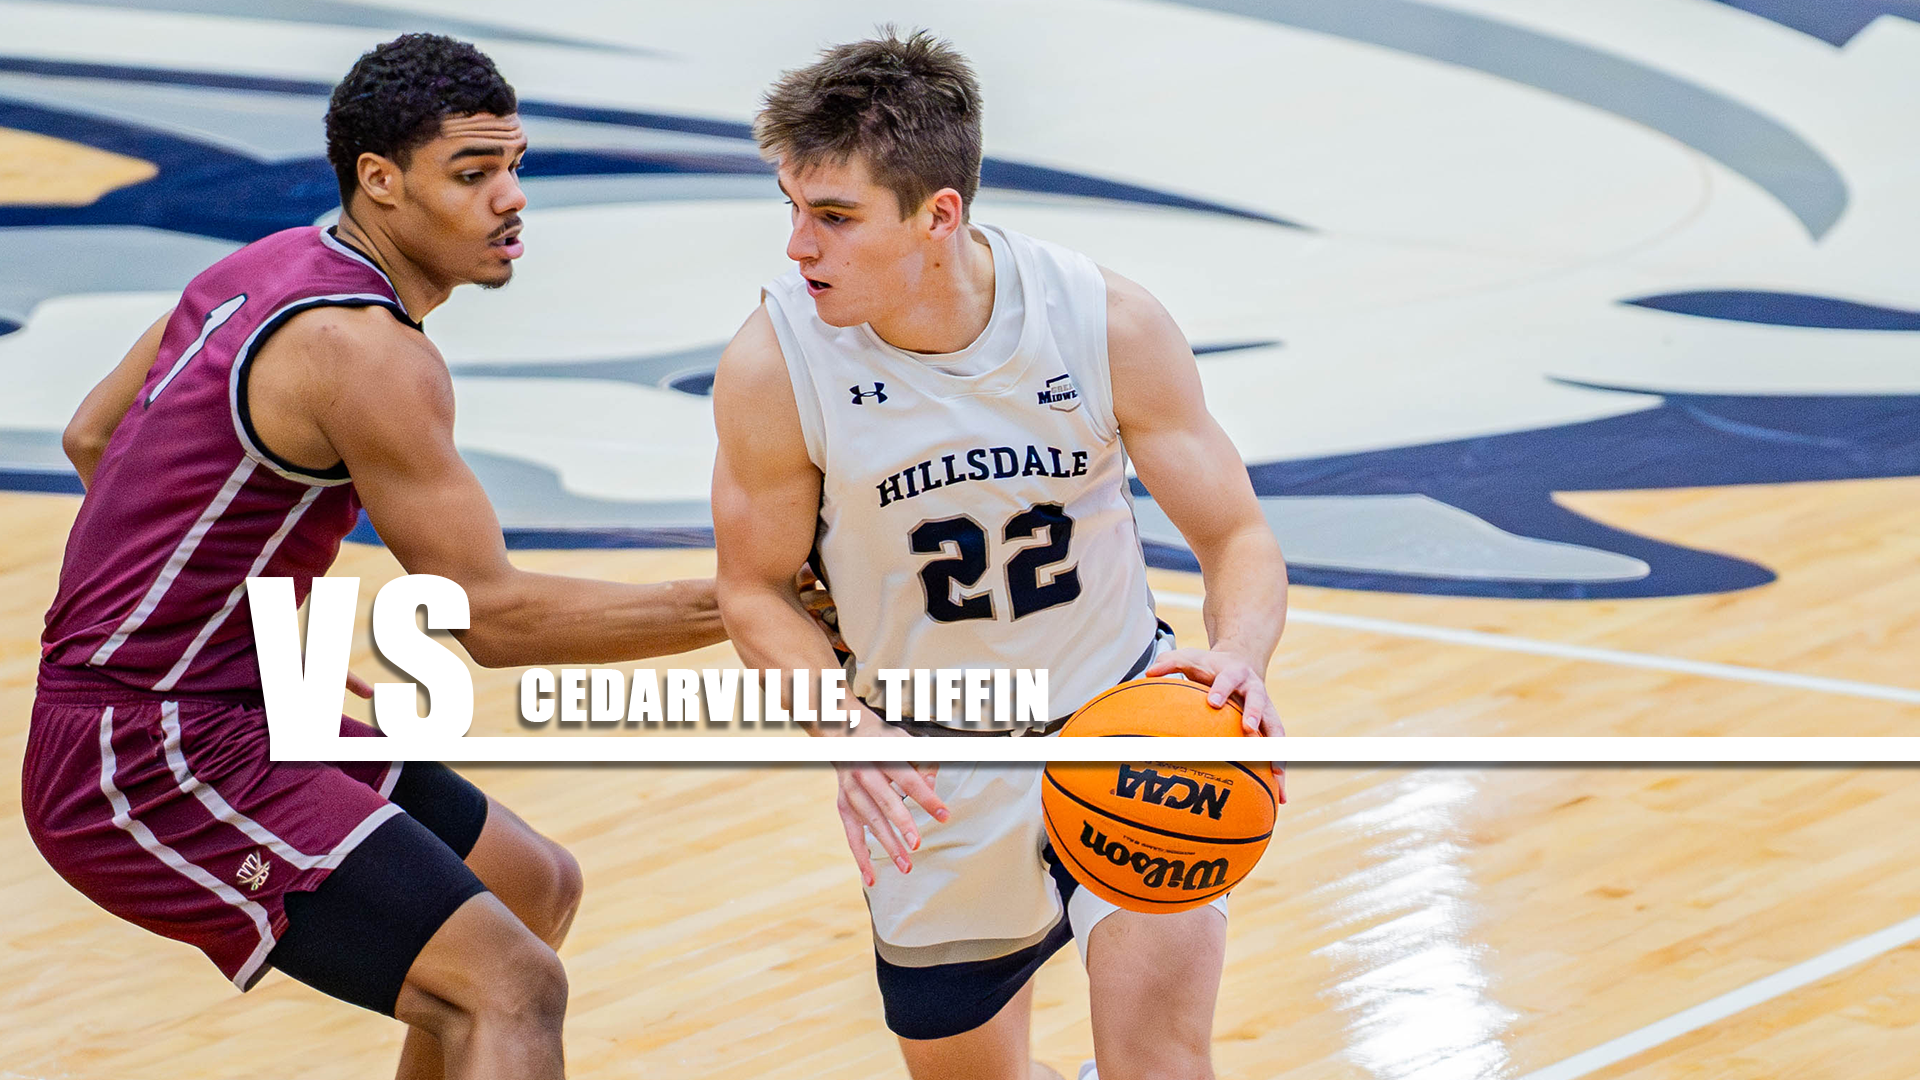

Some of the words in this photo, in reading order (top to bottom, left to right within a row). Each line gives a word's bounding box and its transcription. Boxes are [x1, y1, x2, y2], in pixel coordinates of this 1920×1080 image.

[876, 445, 1088, 507] HILLSDALE
[907, 500, 1083, 623] 22
[1117, 763, 1231, 820] NCAA
[1080, 820, 1229, 890] Wilson
